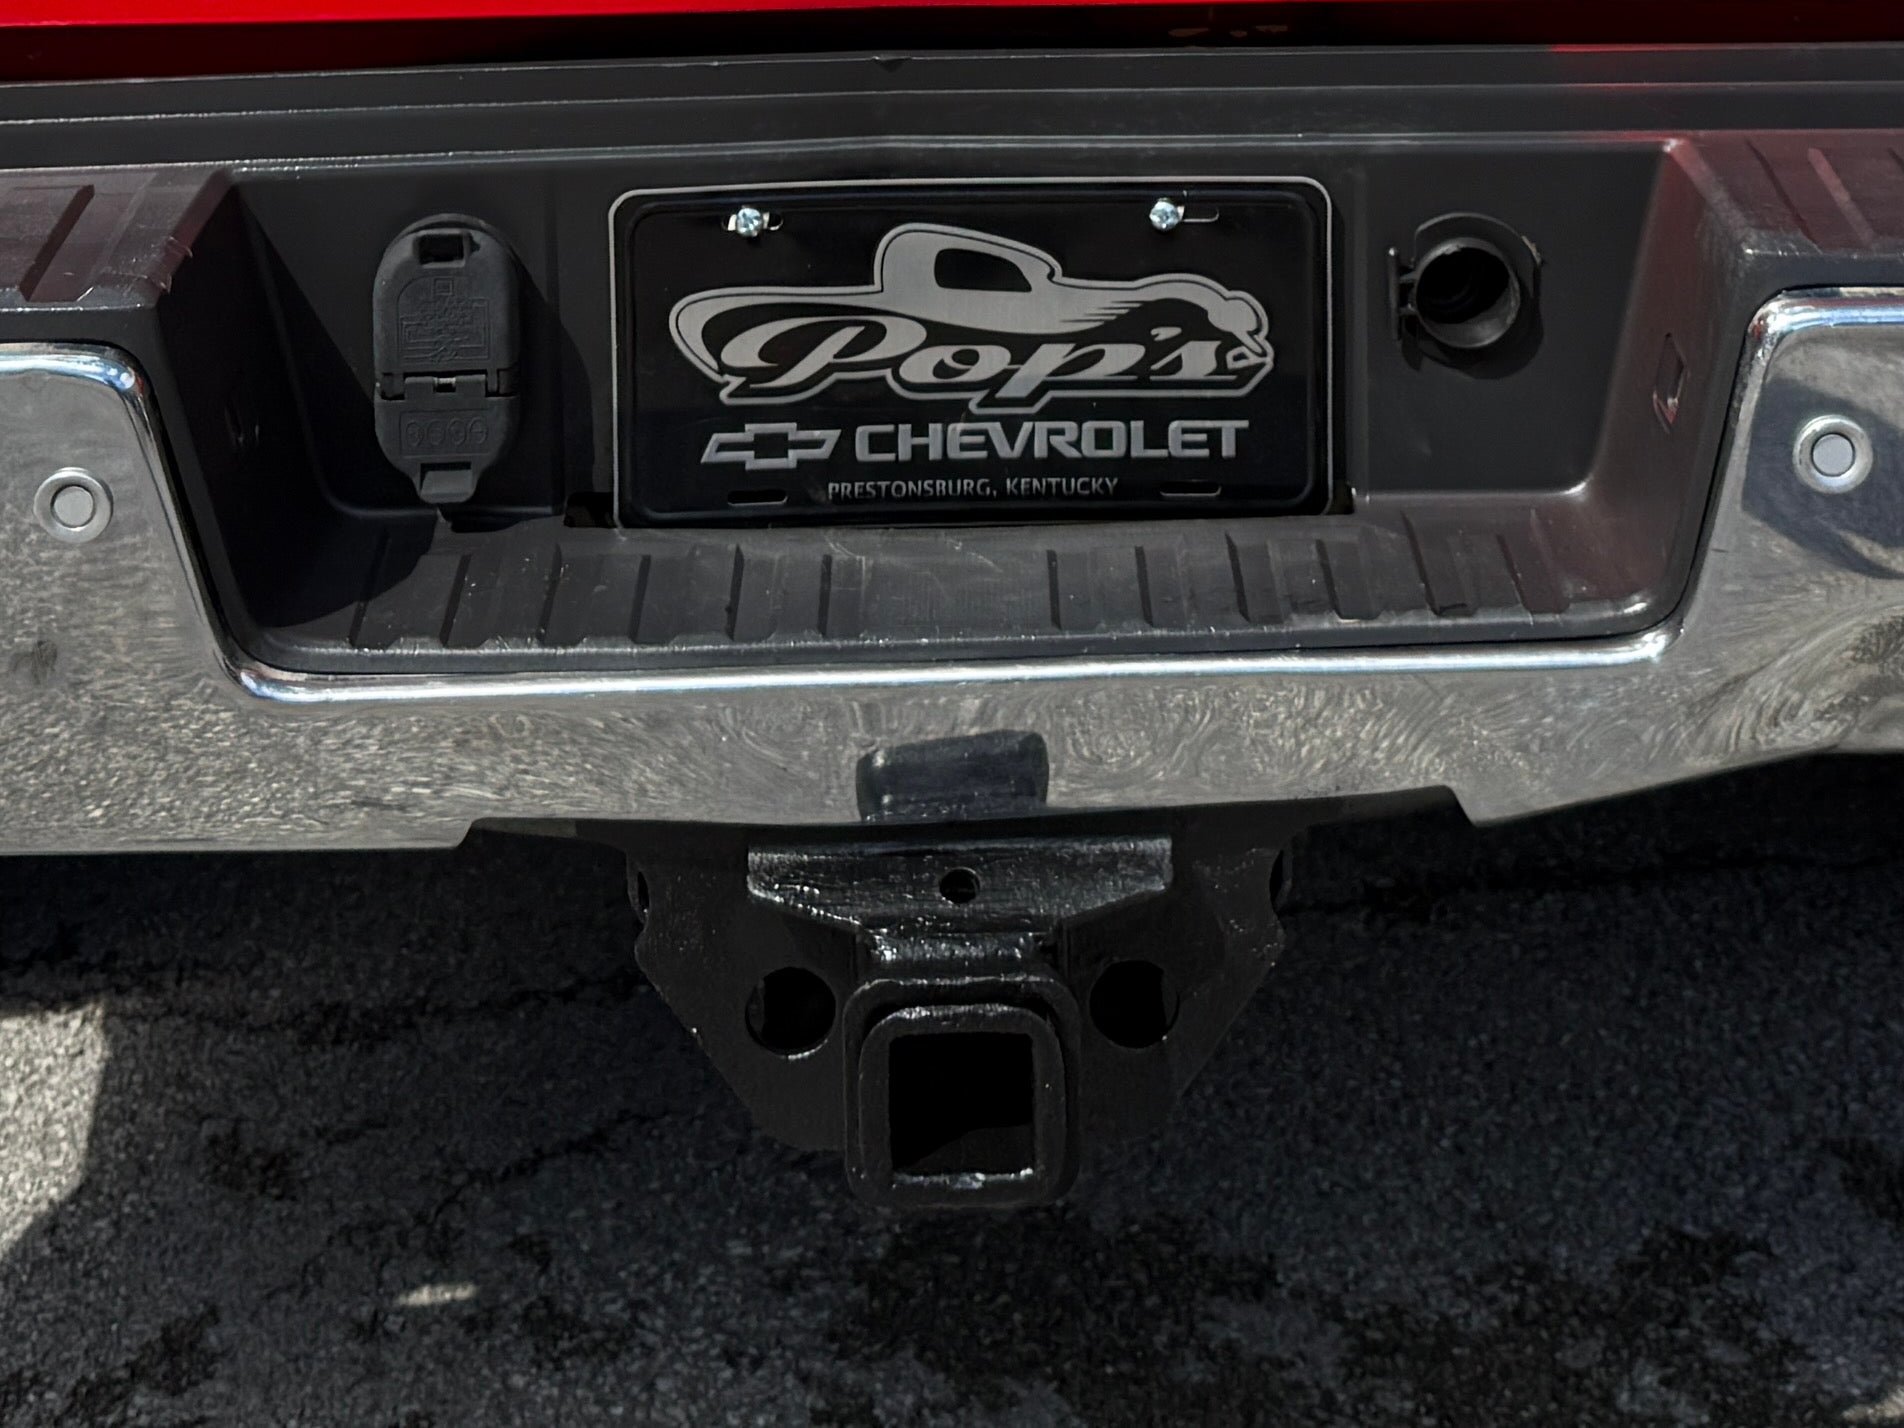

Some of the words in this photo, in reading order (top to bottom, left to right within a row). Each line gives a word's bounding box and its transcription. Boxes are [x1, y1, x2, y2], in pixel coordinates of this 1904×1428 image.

[720, 314, 1238, 398] Pop's
[854, 419, 1250, 462] CHEVROLET
[826, 479, 997, 501] PRESTONSBURG,
[1006, 476, 1120, 498] KENTUCKY
